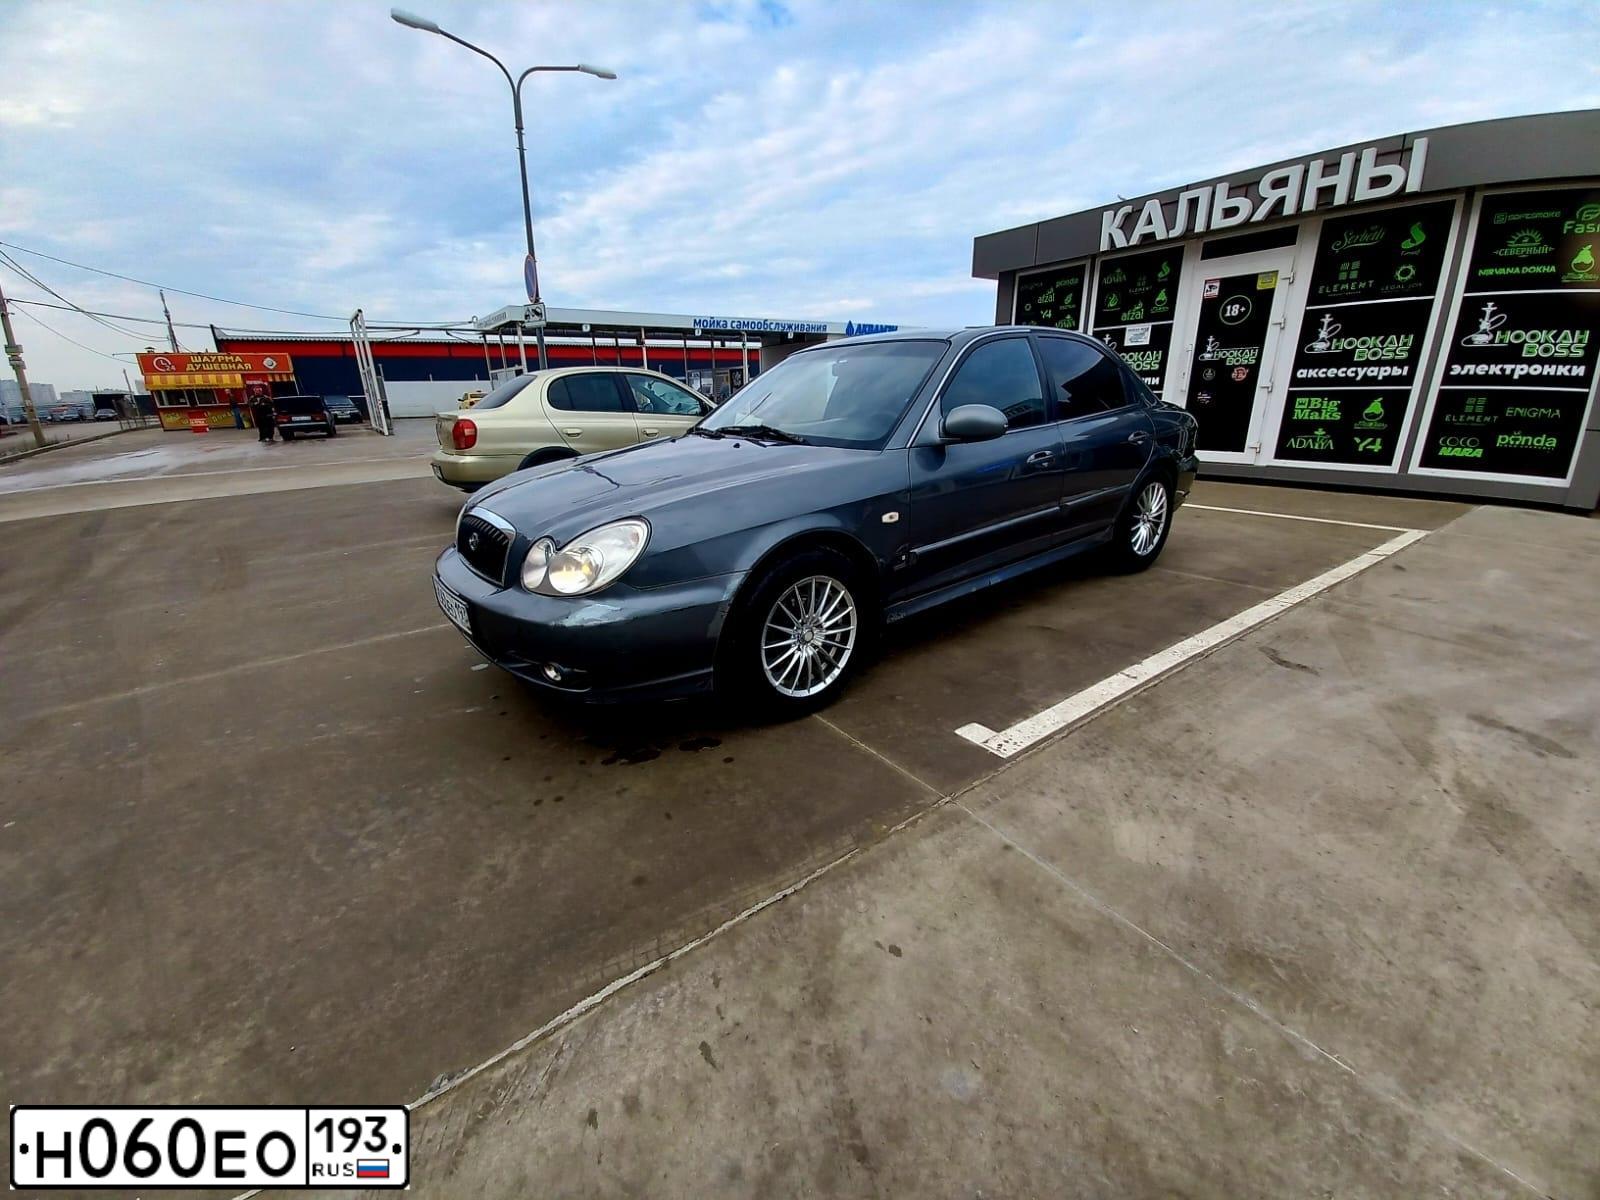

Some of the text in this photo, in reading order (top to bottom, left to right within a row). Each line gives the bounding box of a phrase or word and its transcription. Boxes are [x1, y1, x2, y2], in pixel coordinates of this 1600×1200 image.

[1099, 137, 1428, 251] КАЛЬЯНЫ
[1498, 244, 1549, 257] СЕВЕРНЫЙ
[1521, 265, 1557, 275] DOKHA
[1318, 280, 1375, 294] ELEMENT
[1121, 308, 1145, 321] afzal
[1224, 304, 1247, 317] 18+
[730, 319, 828, 333] самообслуживания
[1331, 334, 1414, 350] HOOKAH
[1494, 329, 1590, 344] HOOKAH
[1119, 350, 1163, 363] OOKAH
[1213, 349, 1259, 360] HOOKAH
[1353, 347, 1409, 361] BOSS
[1521, 343, 1585, 358] BOSS
[190, 355, 243, 363] ШАУРМА
[1225, 357, 1257, 366] BOSS
[185, 363, 252, 372] ДУШЕВНАЯ
[1296, 365, 1409, 381] аксессуары
[1449, 364, 1586, 379] электронки
[1308, 397, 1341, 411] Big
[1292, 409, 1341, 420] Maks
[1445, 414, 1499, 423] ELEMENT
[1505, 407, 1561, 419] ENIGMA
[1439, 436, 1480, 448] COCO
[1496, 432, 1558, 447] panda
[1438, 446, 1484, 458] NARA
